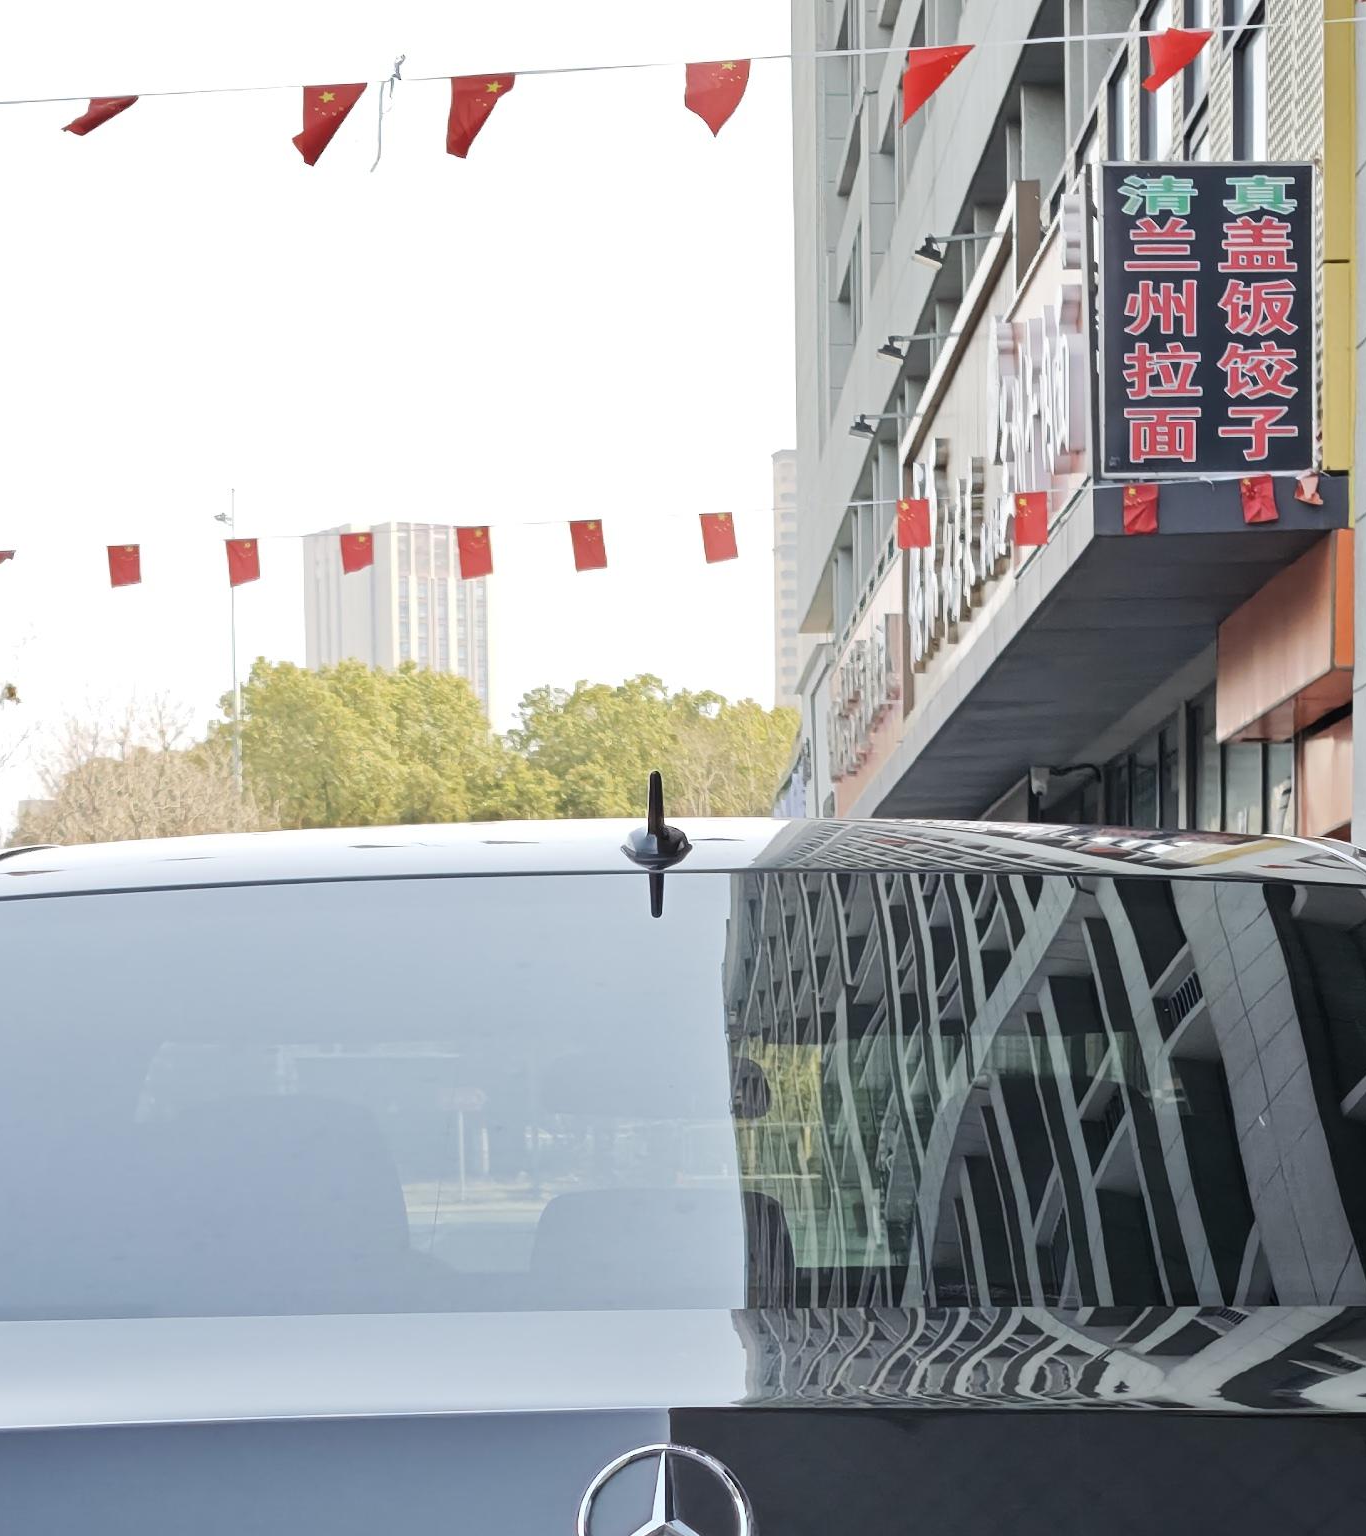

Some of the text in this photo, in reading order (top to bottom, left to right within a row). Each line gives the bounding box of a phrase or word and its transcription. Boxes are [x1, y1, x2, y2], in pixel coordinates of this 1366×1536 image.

[1117, 174, 1298, 216] 清真
[1122, 216, 1203, 464] 兰州拉面
[1216, 214, 1299, 462] 盖饭饺子
